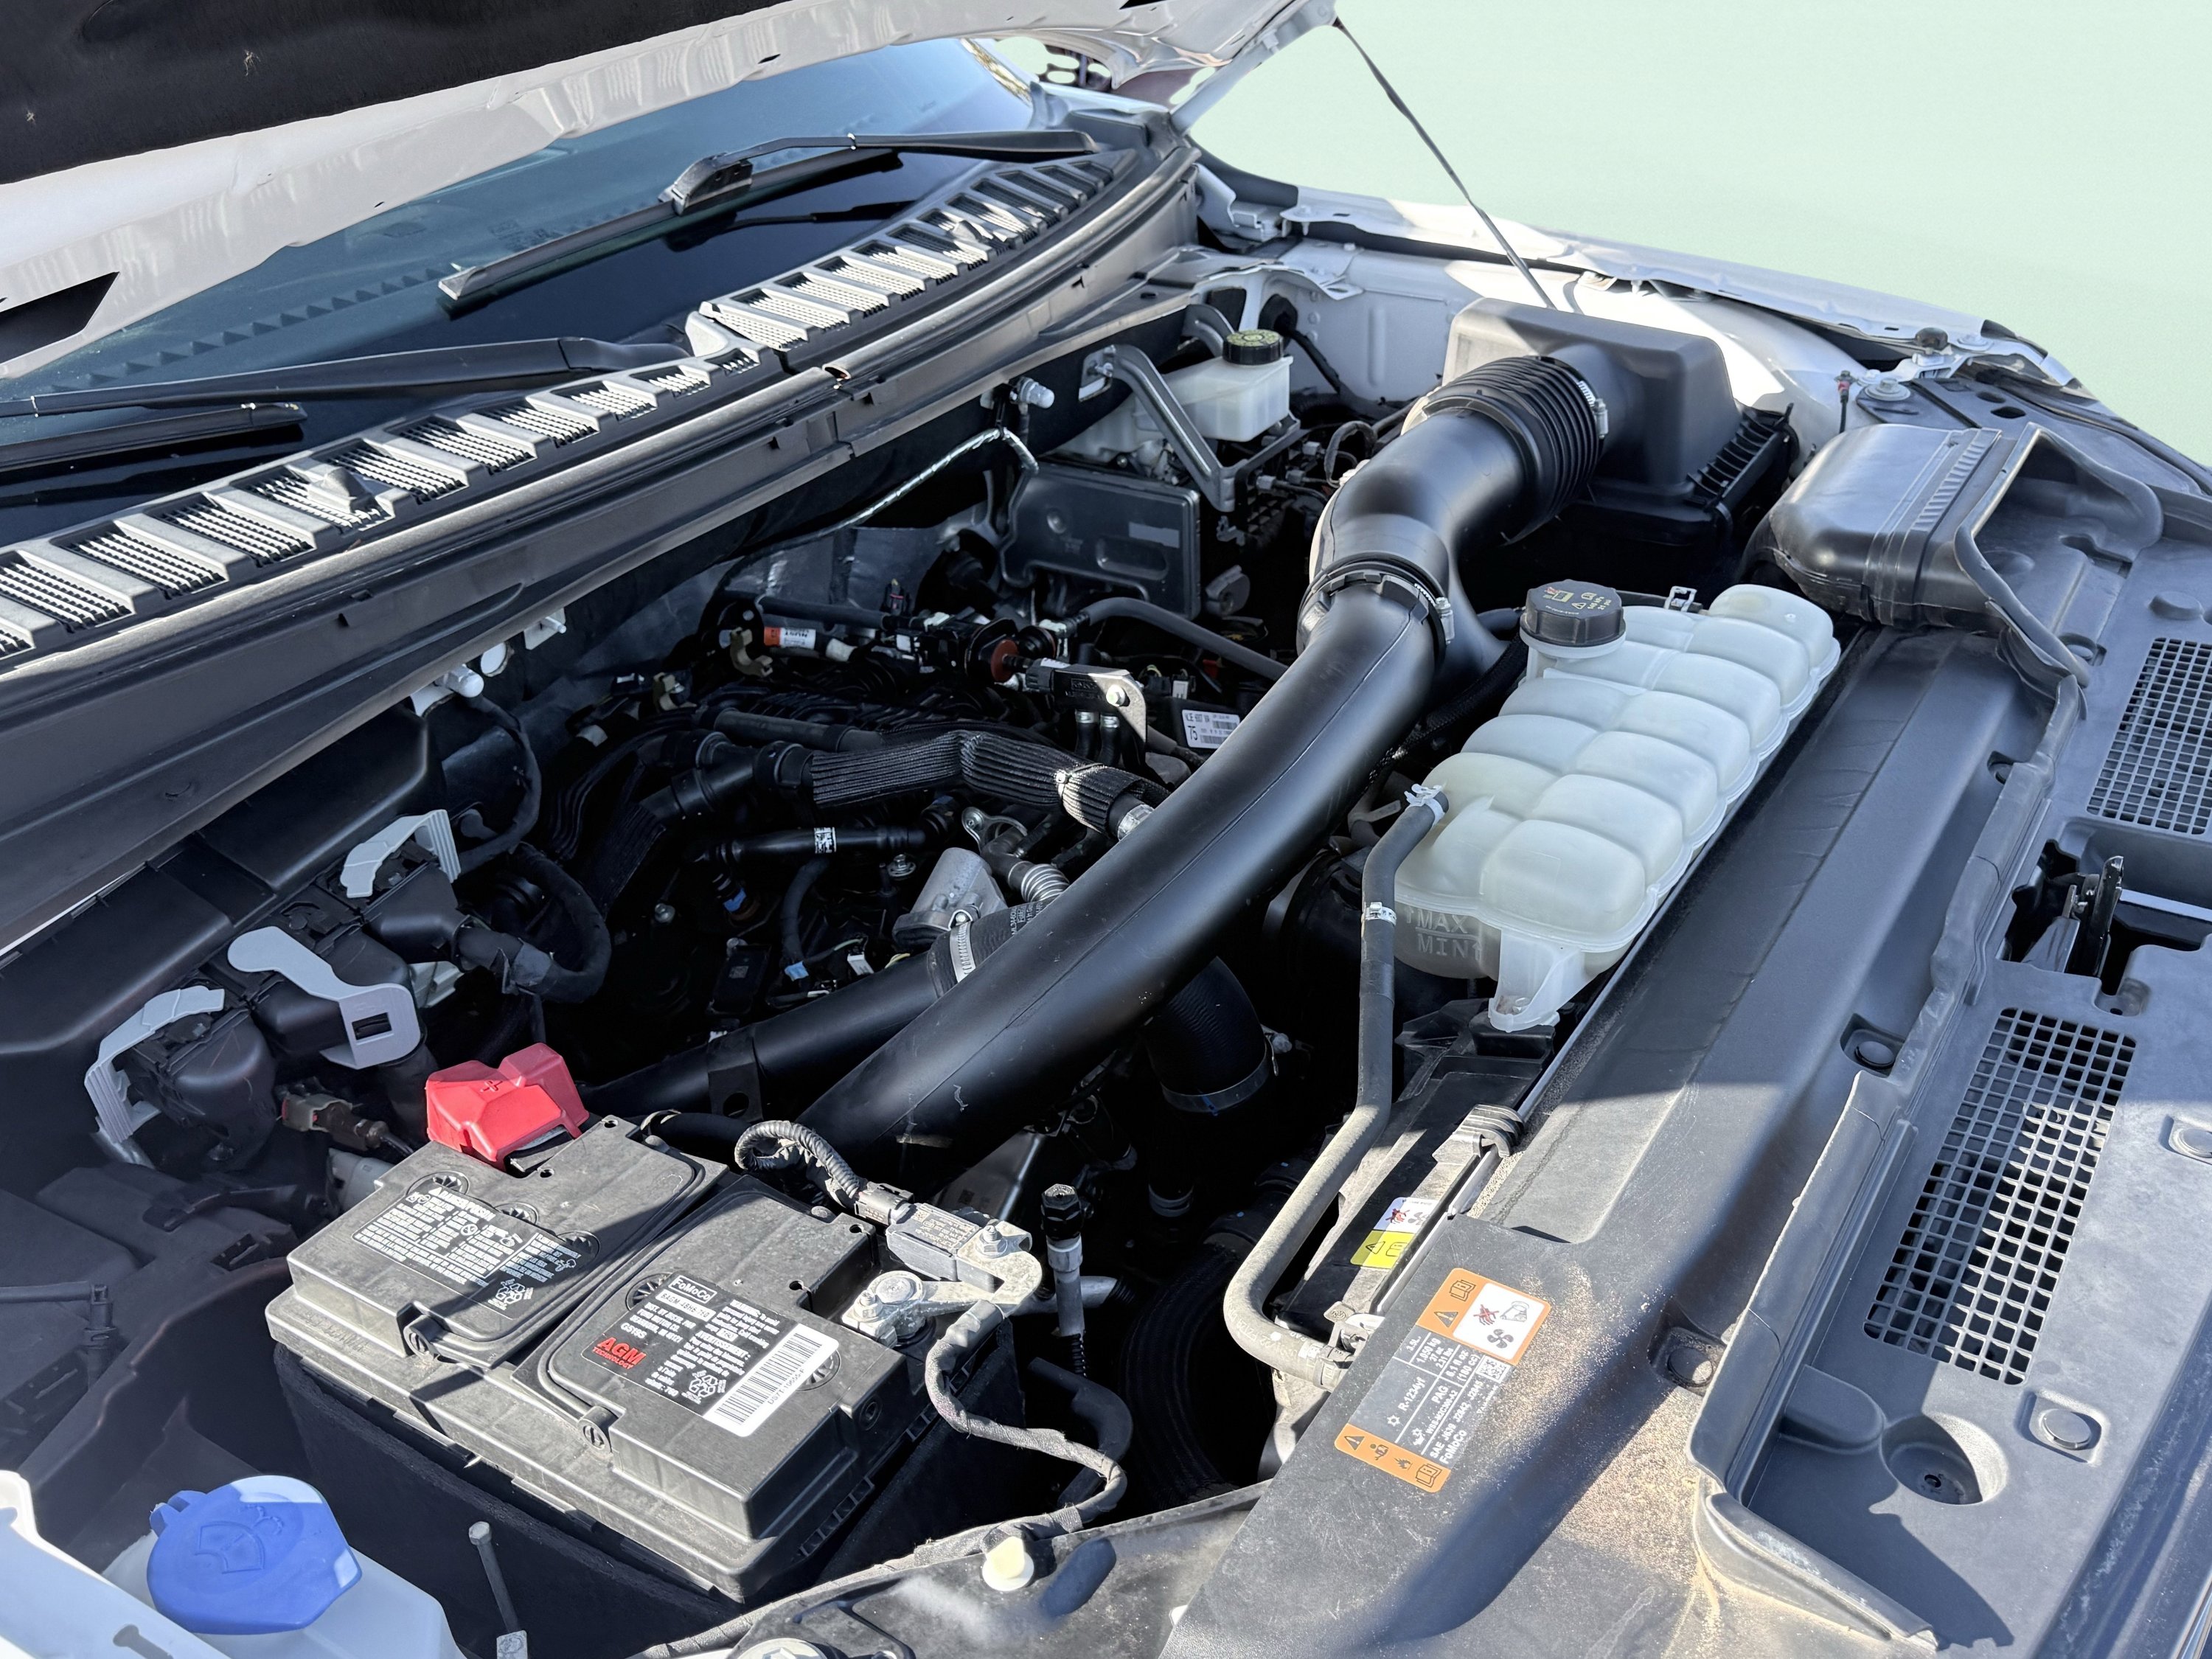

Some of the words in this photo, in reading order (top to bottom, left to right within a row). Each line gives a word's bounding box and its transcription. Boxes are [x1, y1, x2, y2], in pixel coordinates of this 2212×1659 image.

[1419, 911, 1467, 934] MAX
[1418, 935, 1468, 959] MIN
[672, 1279, 712, 1300] FoMoCo
[591, 1346, 633, 1369] TECHNOLOGY
[597, 1337, 647, 1365] AGM
[1398, 1377, 1427, 1411] R-1234yf
[1432, 1385, 1449, 1403] PAG
[1430, 1442, 1445, 1458] SAE
[1439, 1430, 1467, 1464] FoMoCo
